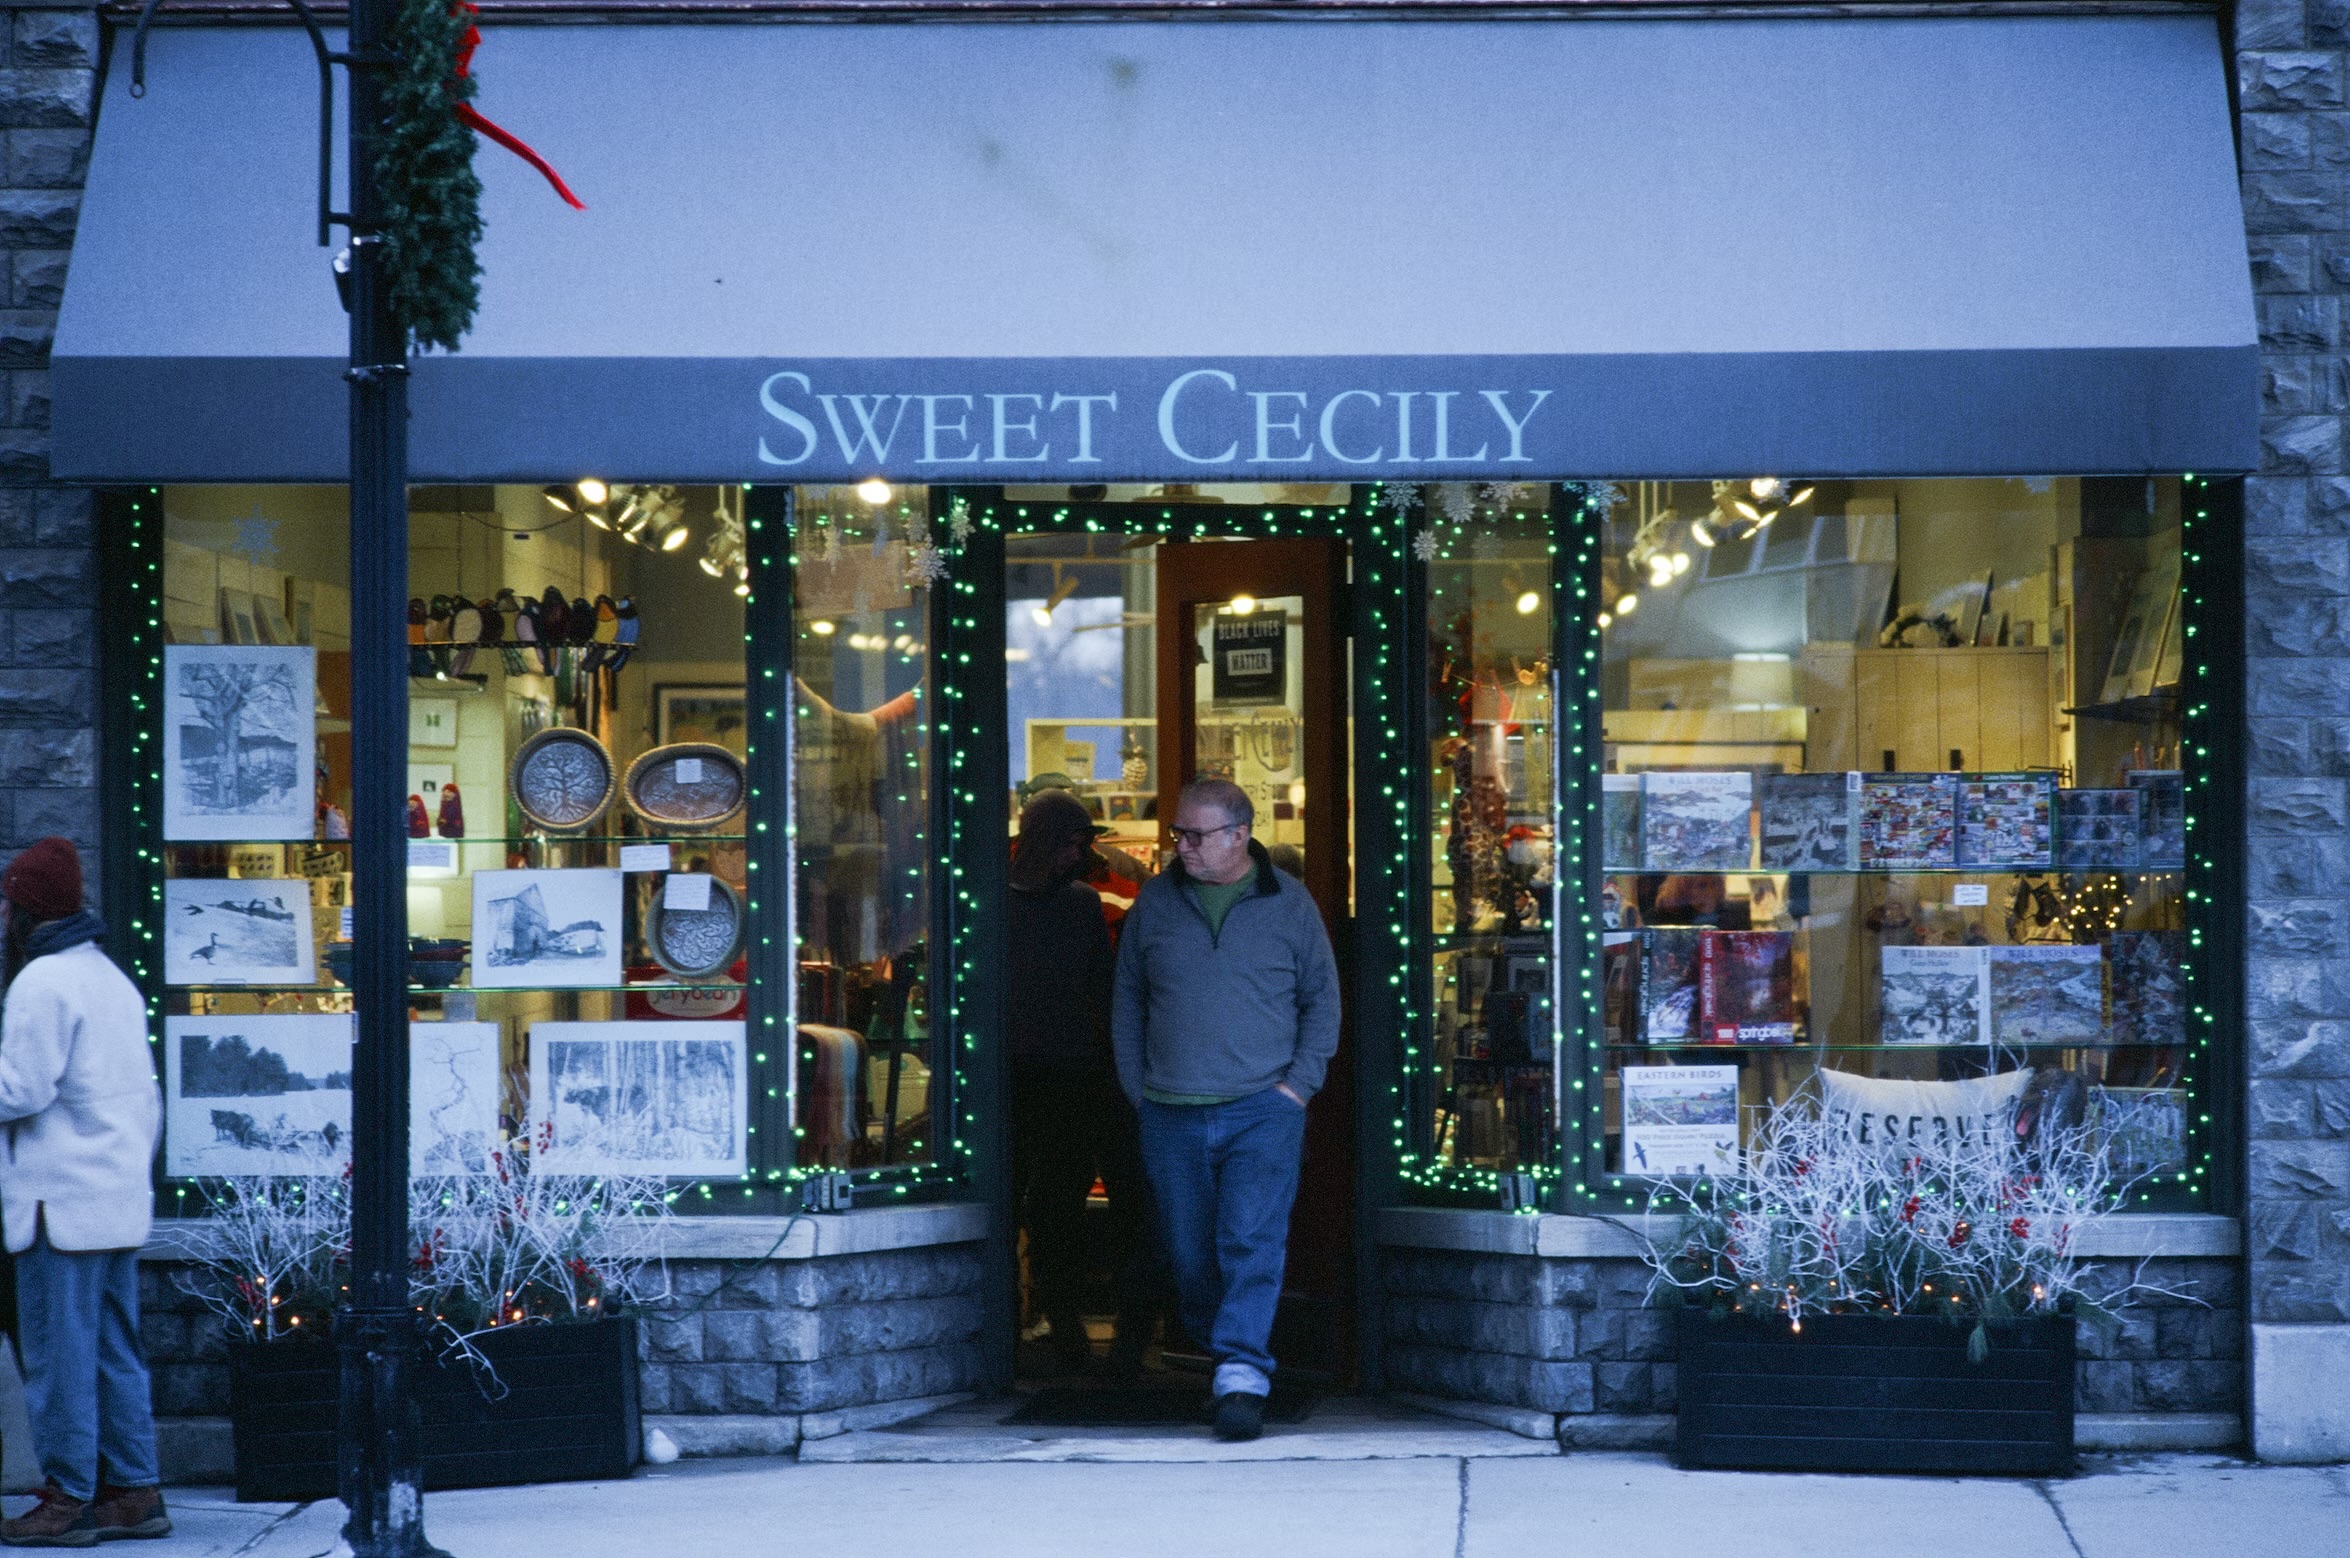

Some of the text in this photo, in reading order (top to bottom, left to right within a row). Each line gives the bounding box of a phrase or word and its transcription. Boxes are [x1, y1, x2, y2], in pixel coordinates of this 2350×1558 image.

[757, 369, 1553, 467] SWEET CECILY
[1218, 620, 1281, 640] BLACK LIVES
[1232, 653, 1267, 670] MATTER
[1637, 1070, 1722, 1080] EASTERN BIRDS
